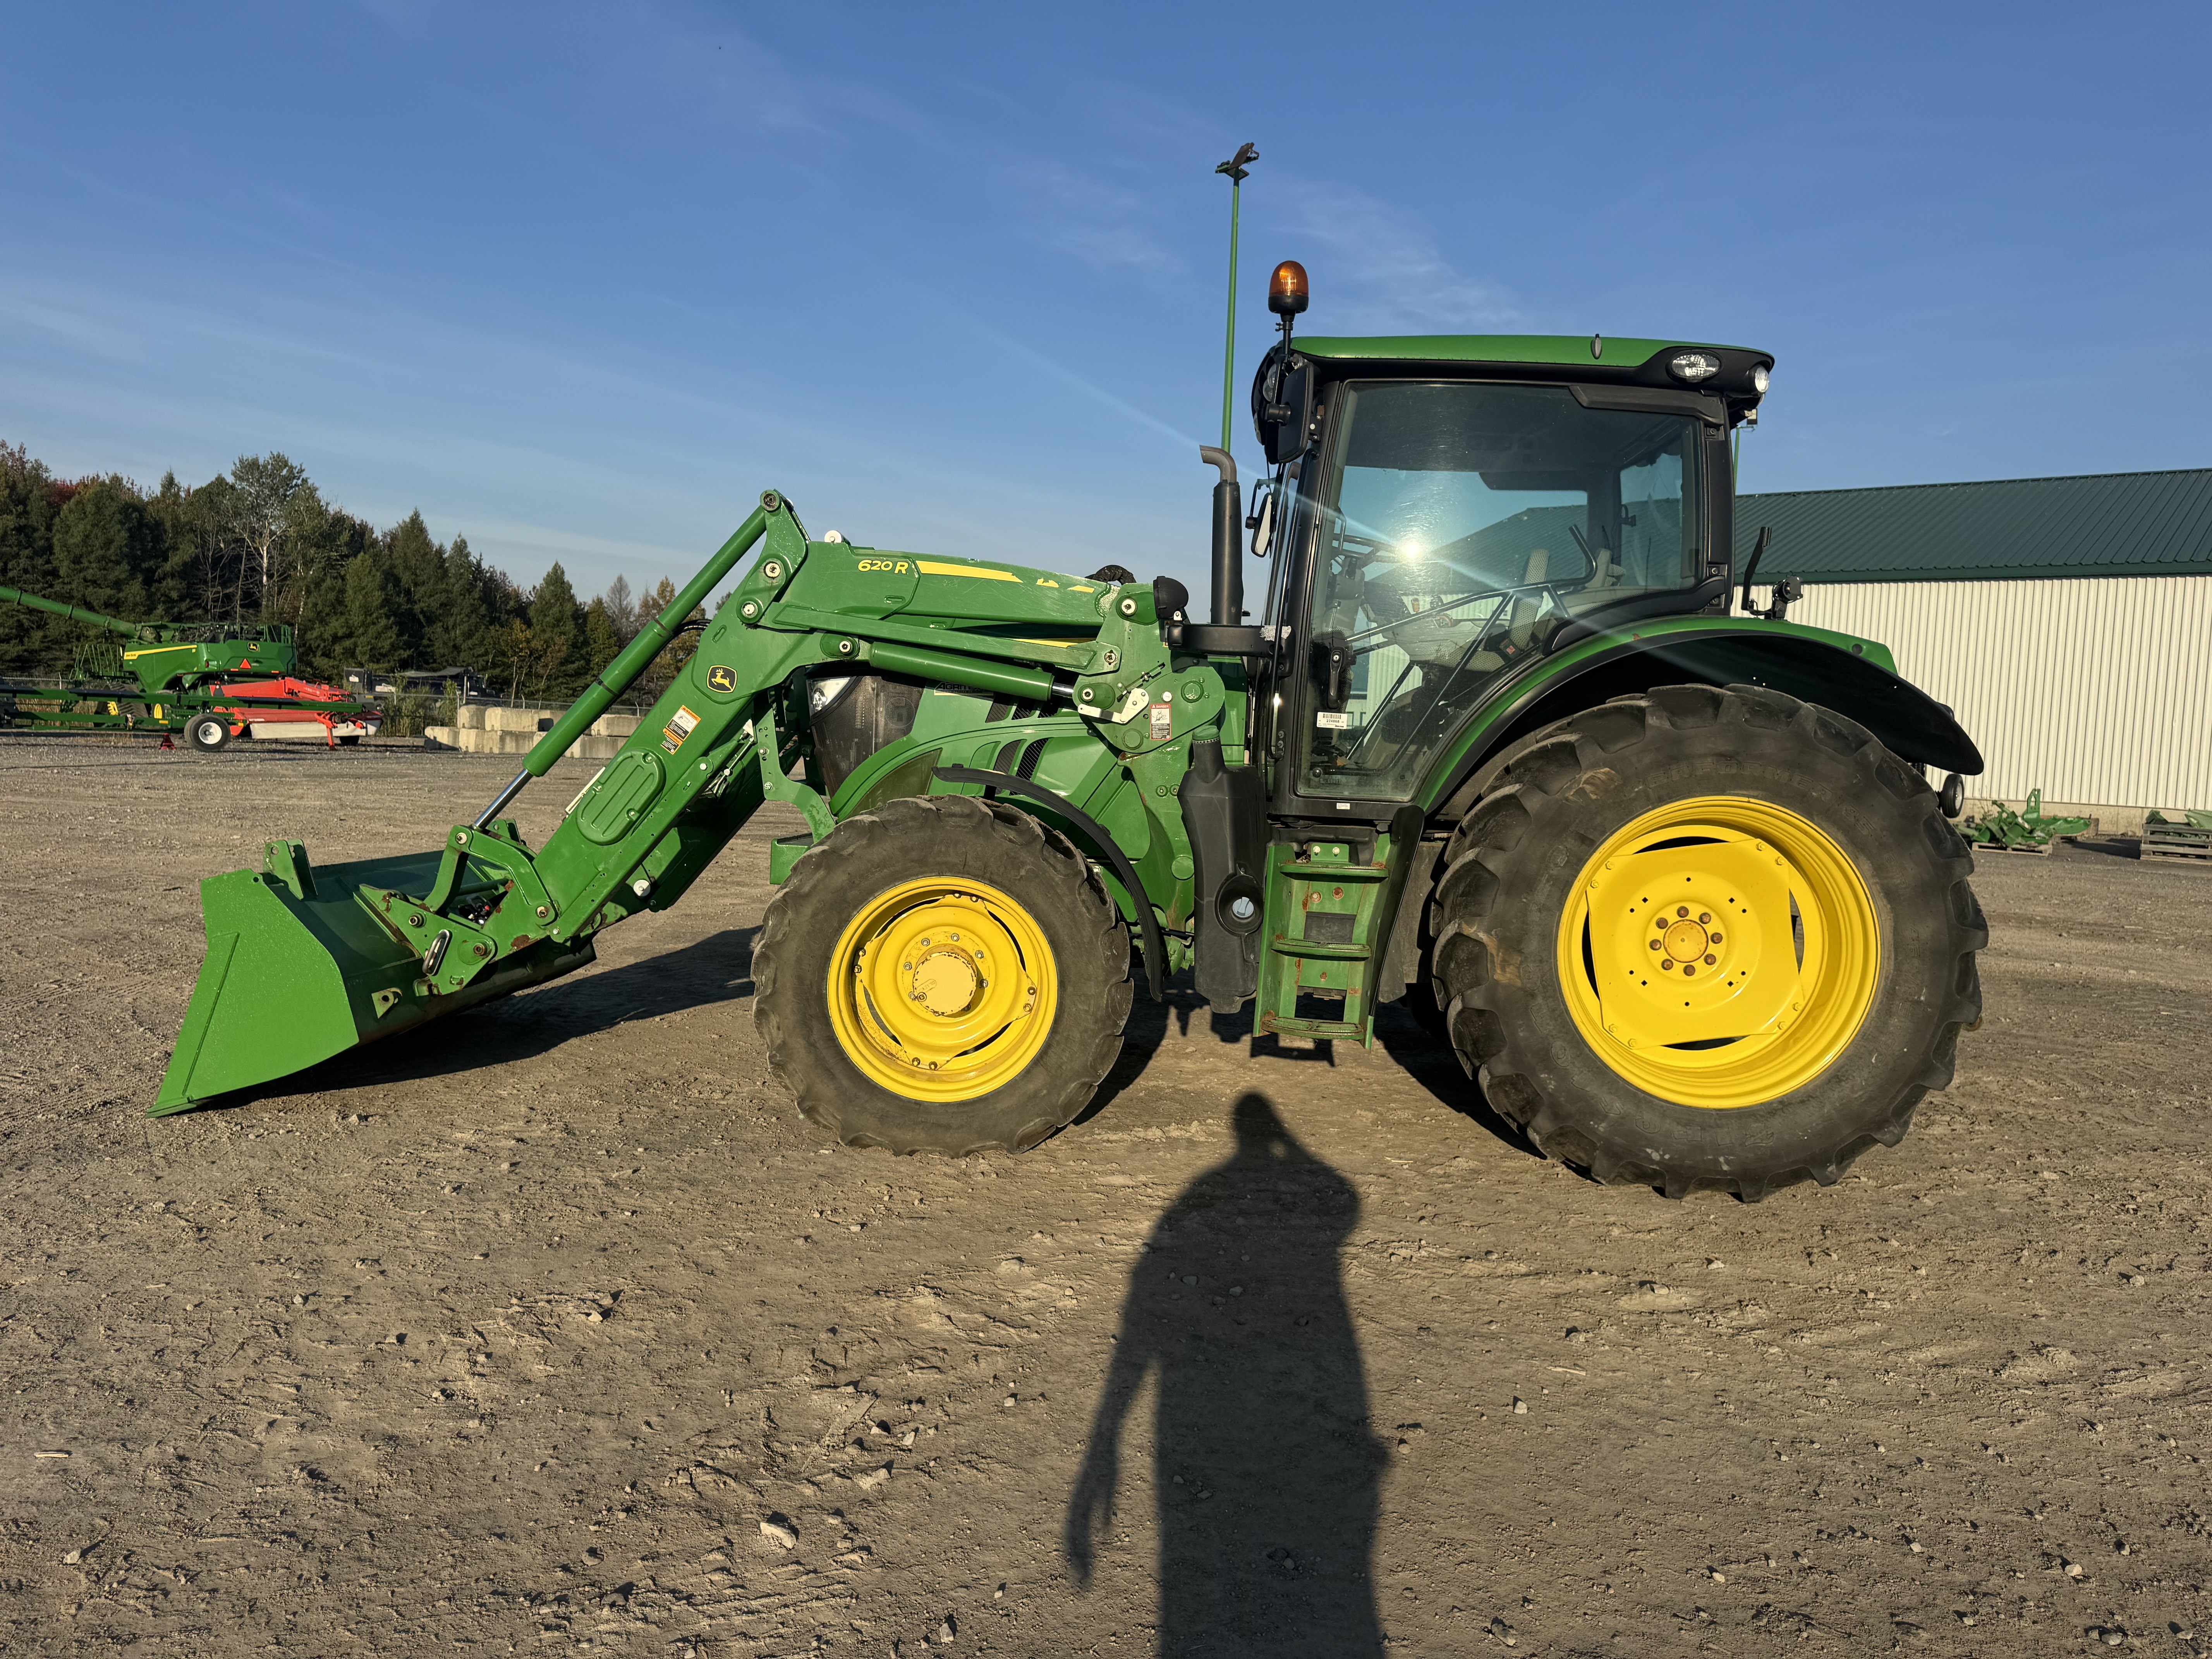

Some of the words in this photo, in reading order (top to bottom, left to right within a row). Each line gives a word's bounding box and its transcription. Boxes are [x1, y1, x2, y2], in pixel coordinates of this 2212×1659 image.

[858, 560, 893, 571] 620
[894, 562, 908, 574] R
[686, 709, 698, 720] WARNING
